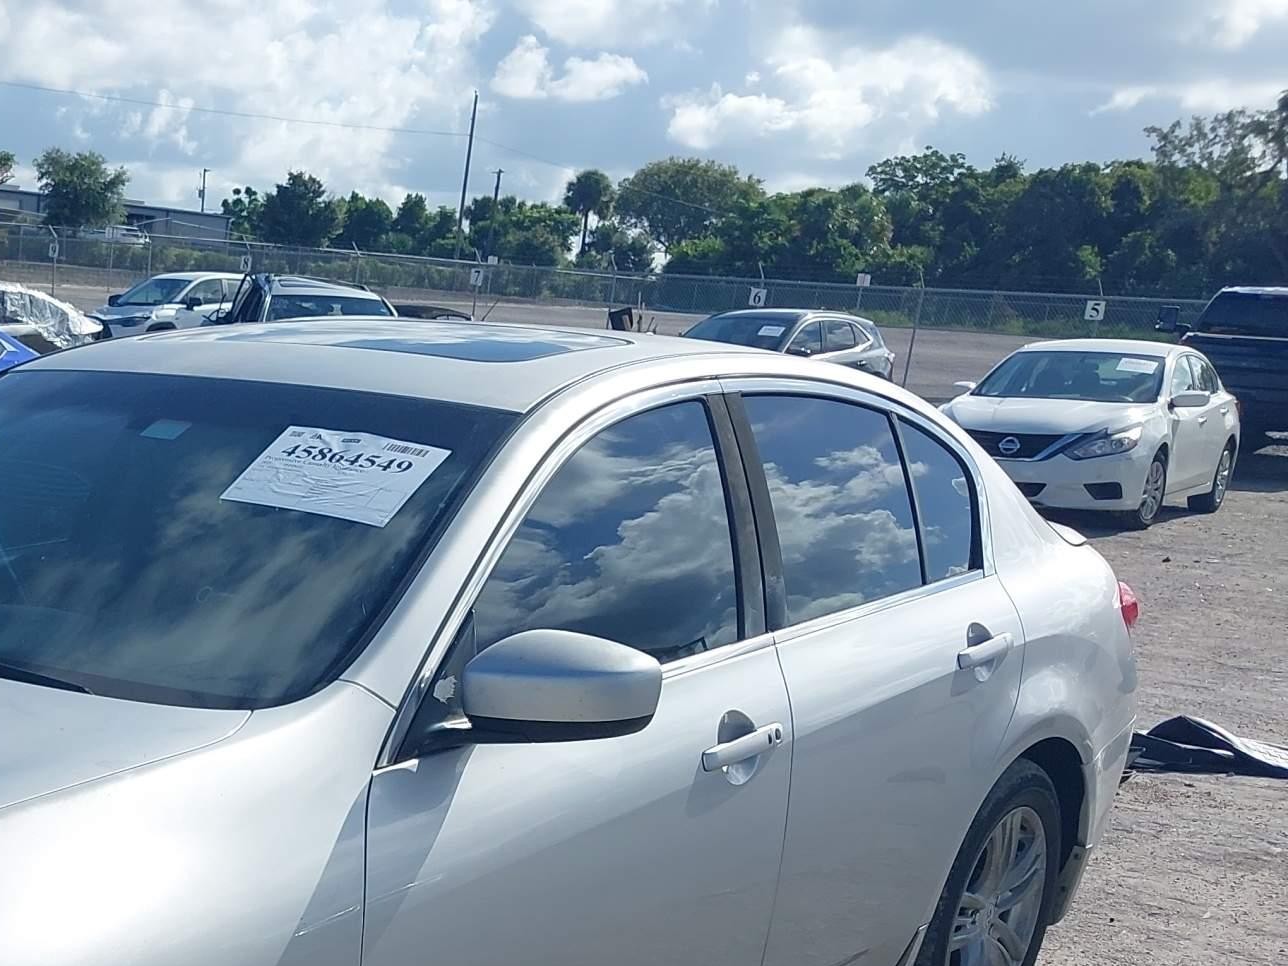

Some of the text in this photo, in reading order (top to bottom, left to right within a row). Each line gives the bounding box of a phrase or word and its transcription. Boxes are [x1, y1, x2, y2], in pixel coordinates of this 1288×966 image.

[242, 256, 250, 270] 8
[474, 270, 481, 283] 7
[753, 290, 761, 305] 6
[1089, 303, 1100, 318] 5
[280, 443, 414, 474] 45864549
